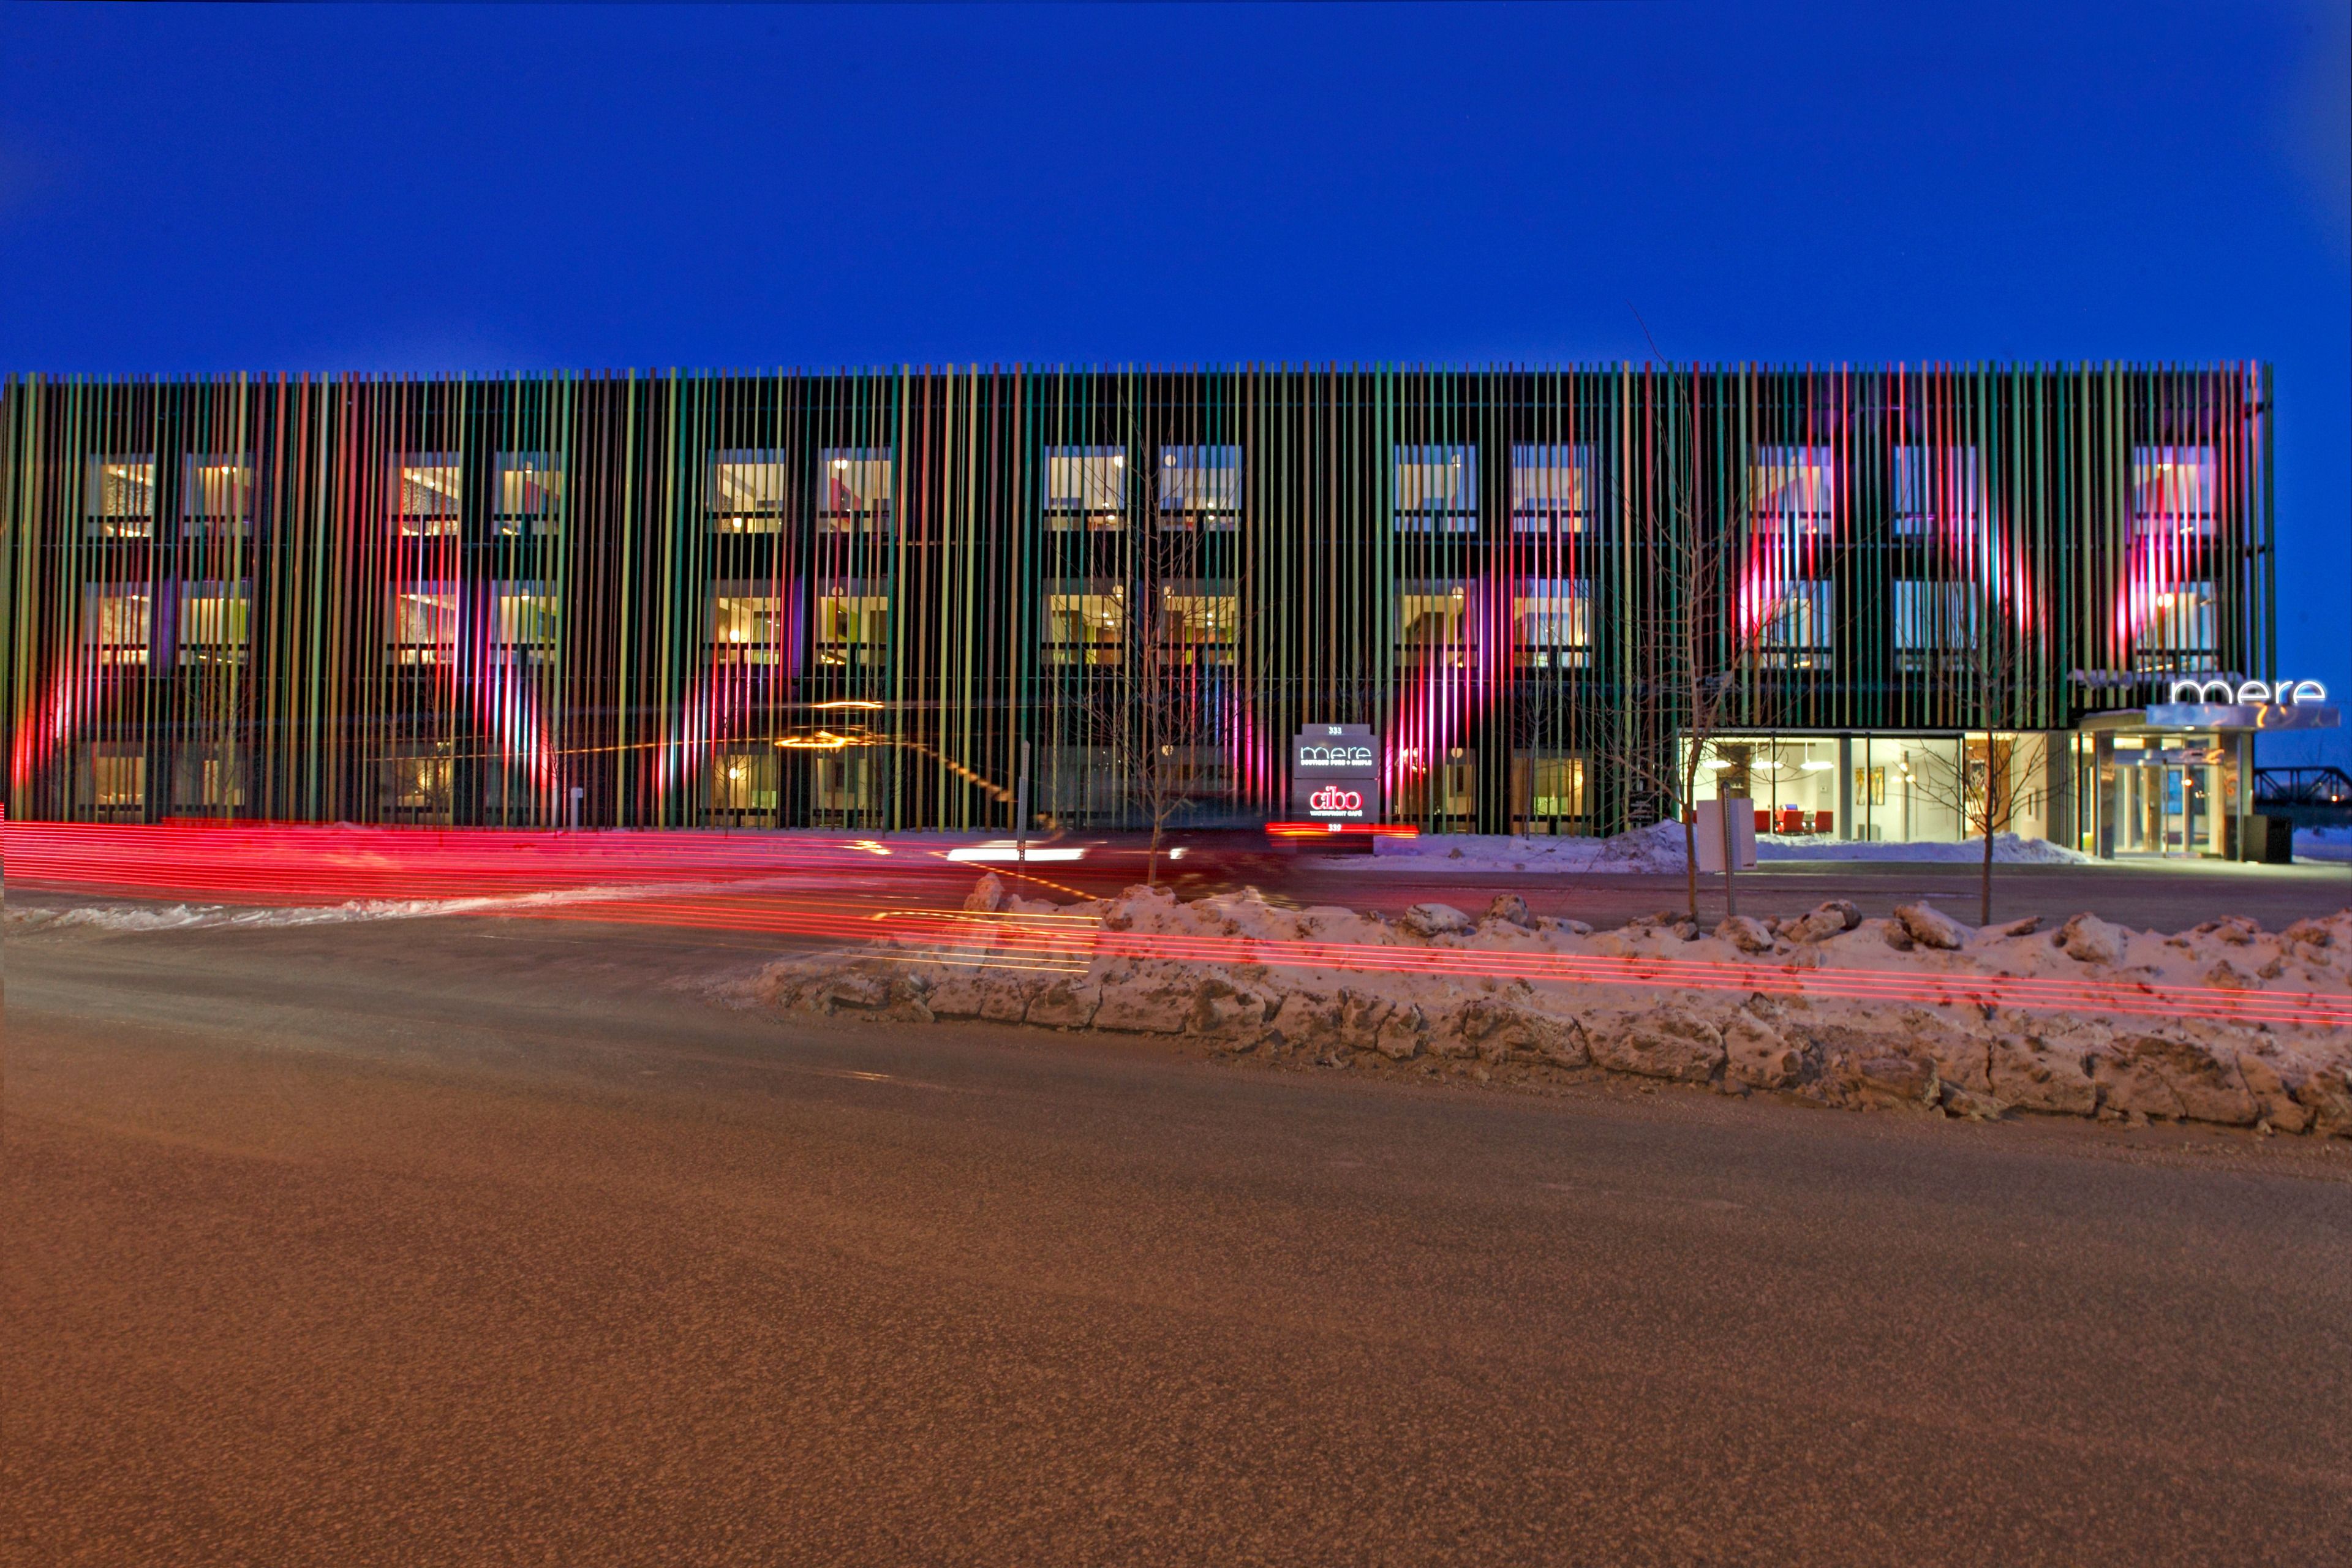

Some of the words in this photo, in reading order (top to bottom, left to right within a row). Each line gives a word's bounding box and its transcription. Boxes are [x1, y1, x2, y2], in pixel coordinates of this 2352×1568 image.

[2171, 680, 2326, 705] mere
[1300, 747, 1372, 760] mere
[1310, 786, 1363, 810] cibo
